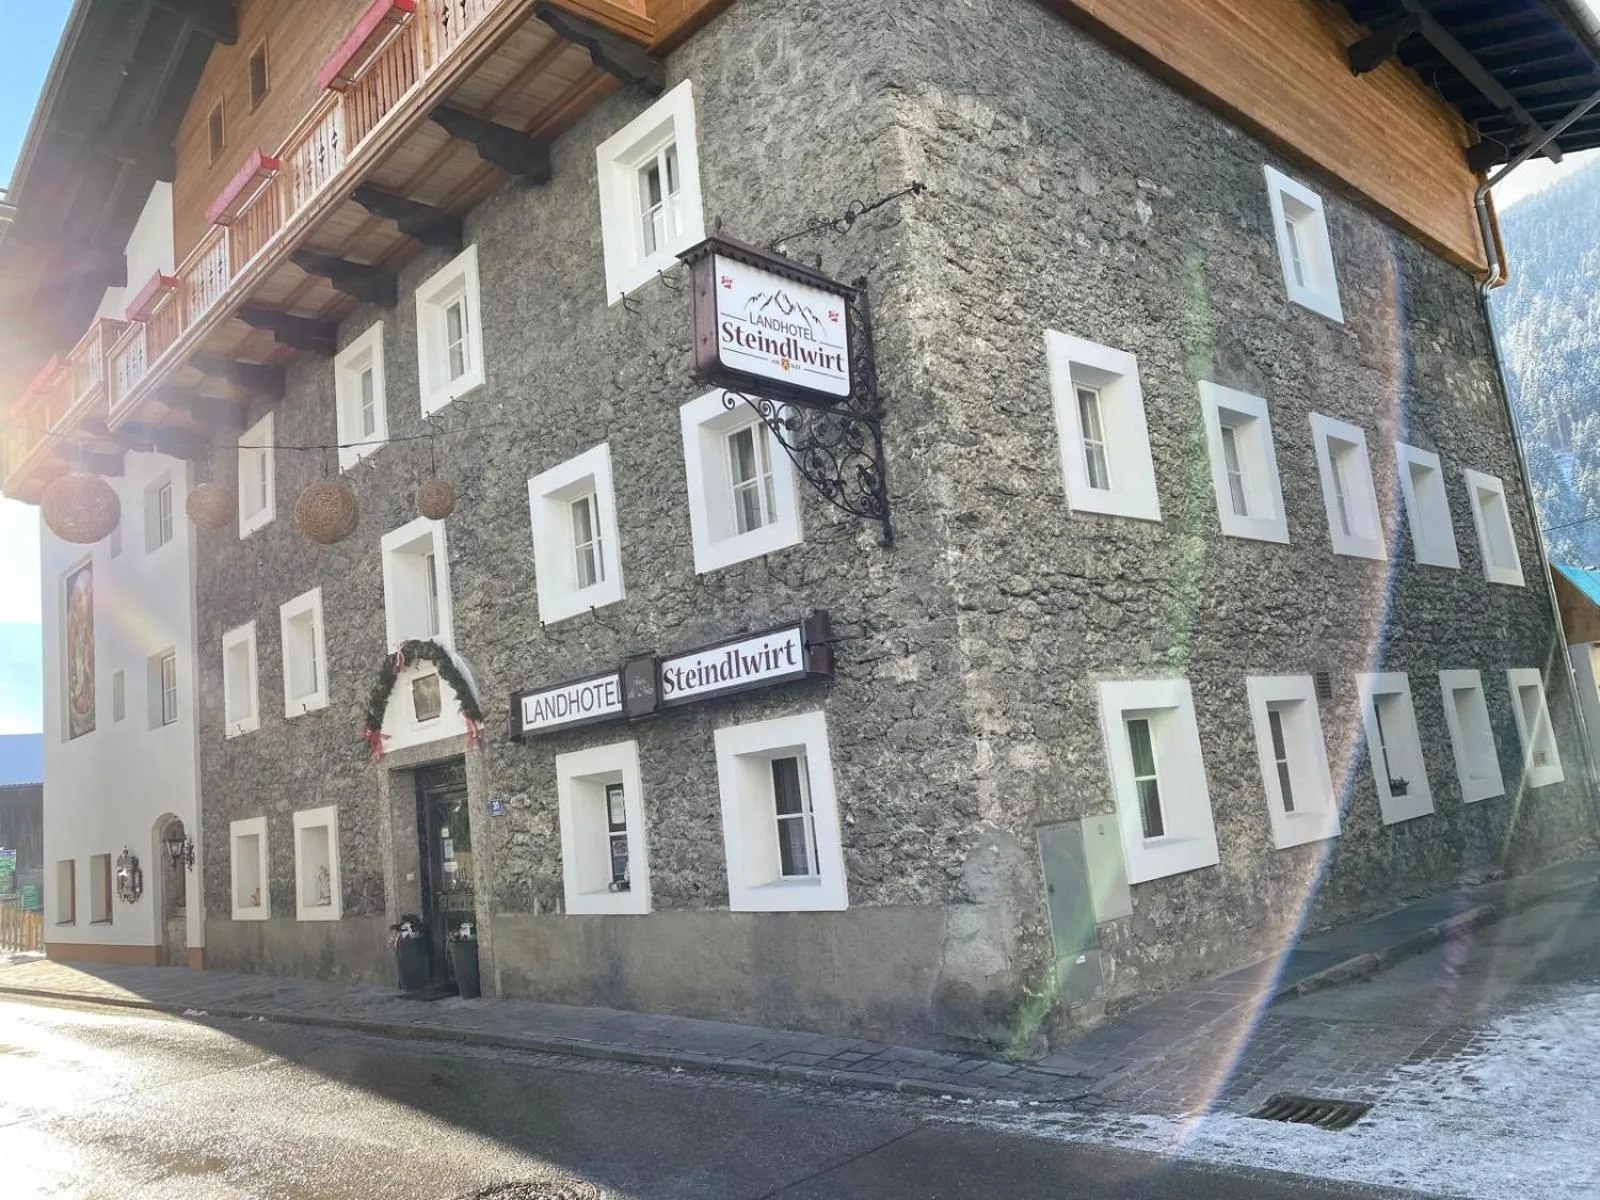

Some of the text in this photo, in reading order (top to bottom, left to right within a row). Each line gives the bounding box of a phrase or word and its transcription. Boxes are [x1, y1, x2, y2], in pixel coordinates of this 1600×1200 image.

[722, 322, 845, 372] Steindlwirt
[750, 312, 816, 342] LANDHOTEL
[525, 680, 621, 724] LANDHOTEL
[663, 638, 797, 694] Steindlwirt
